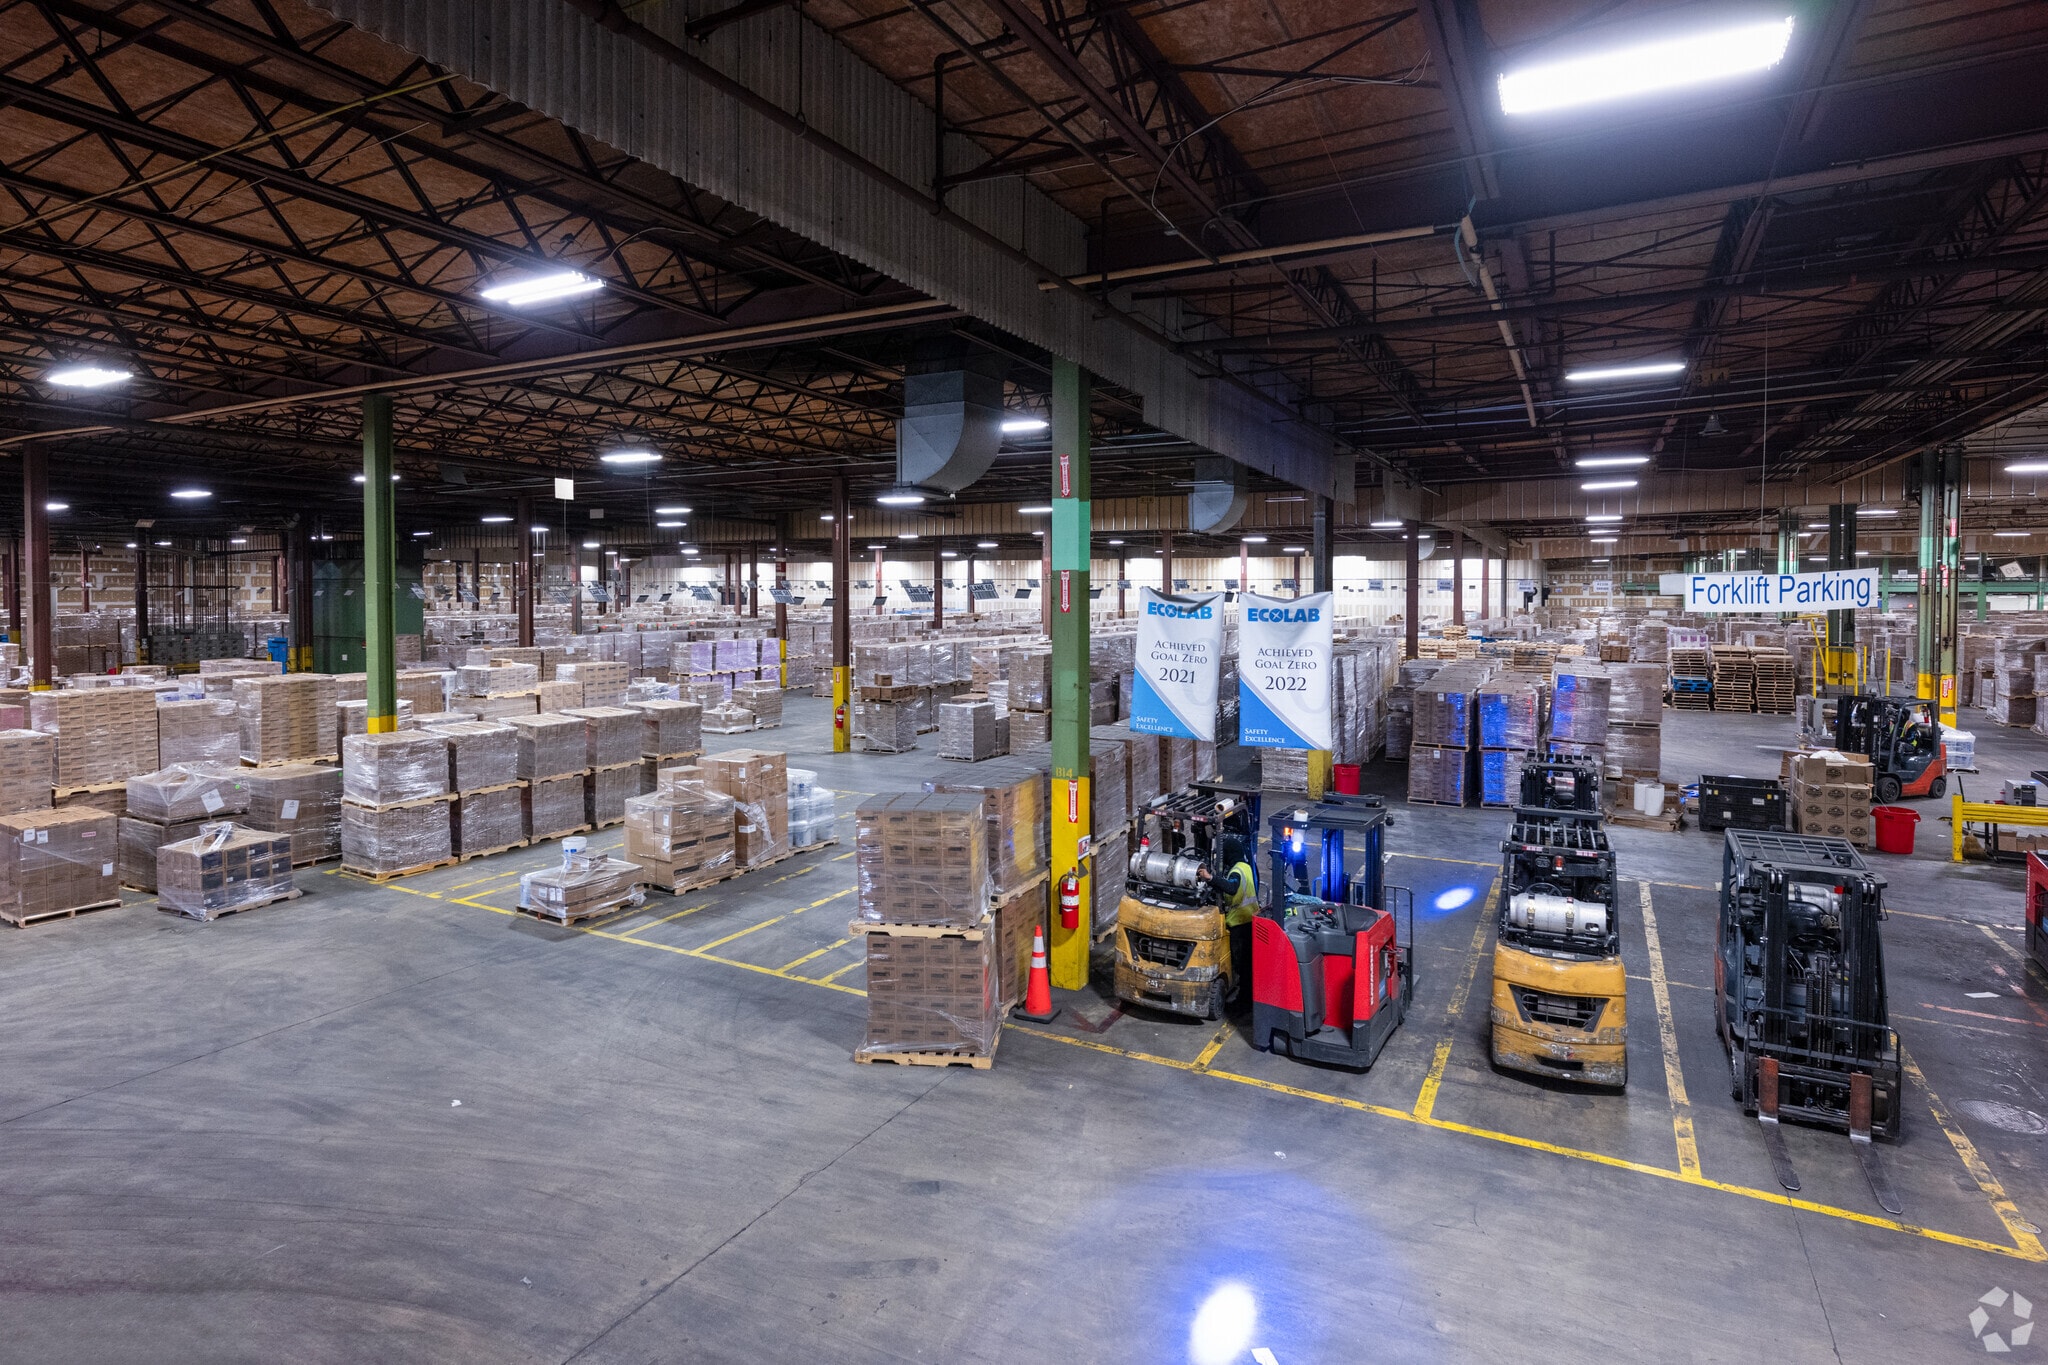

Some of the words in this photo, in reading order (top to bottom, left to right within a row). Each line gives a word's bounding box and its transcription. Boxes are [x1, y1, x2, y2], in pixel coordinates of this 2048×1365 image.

[1692, 575, 1770, 605] Forklift
[1779, 572, 1871, 607] Parking
[1147, 601, 1213, 620] ECOLAB
[1247, 608, 1320, 623] ECOLAB
[1154, 640, 1206, 652] ACHIEVED
[1257, 647, 1313, 657] ACHIEVED
[1150, 651, 1179, 662] GOAL
[1182, 653, 1208, 665] ZERO
[1254, 660, 1284, 669] GOAL
[1287, 660, 1317, 670] ZERO
[1159, 667, 1196, 684] 2021
[1265, 675, 1307, 691] 2022
[1136, 715, 1158, 724] SAFETY
[1136, 723, 1174, 733] EXCELLENCE
[1245, 727, 1269, 735] SAFETY
[1245, 735, 1286, 744] EXCELLENCE
[1055, 766, 1073, 779] B14
